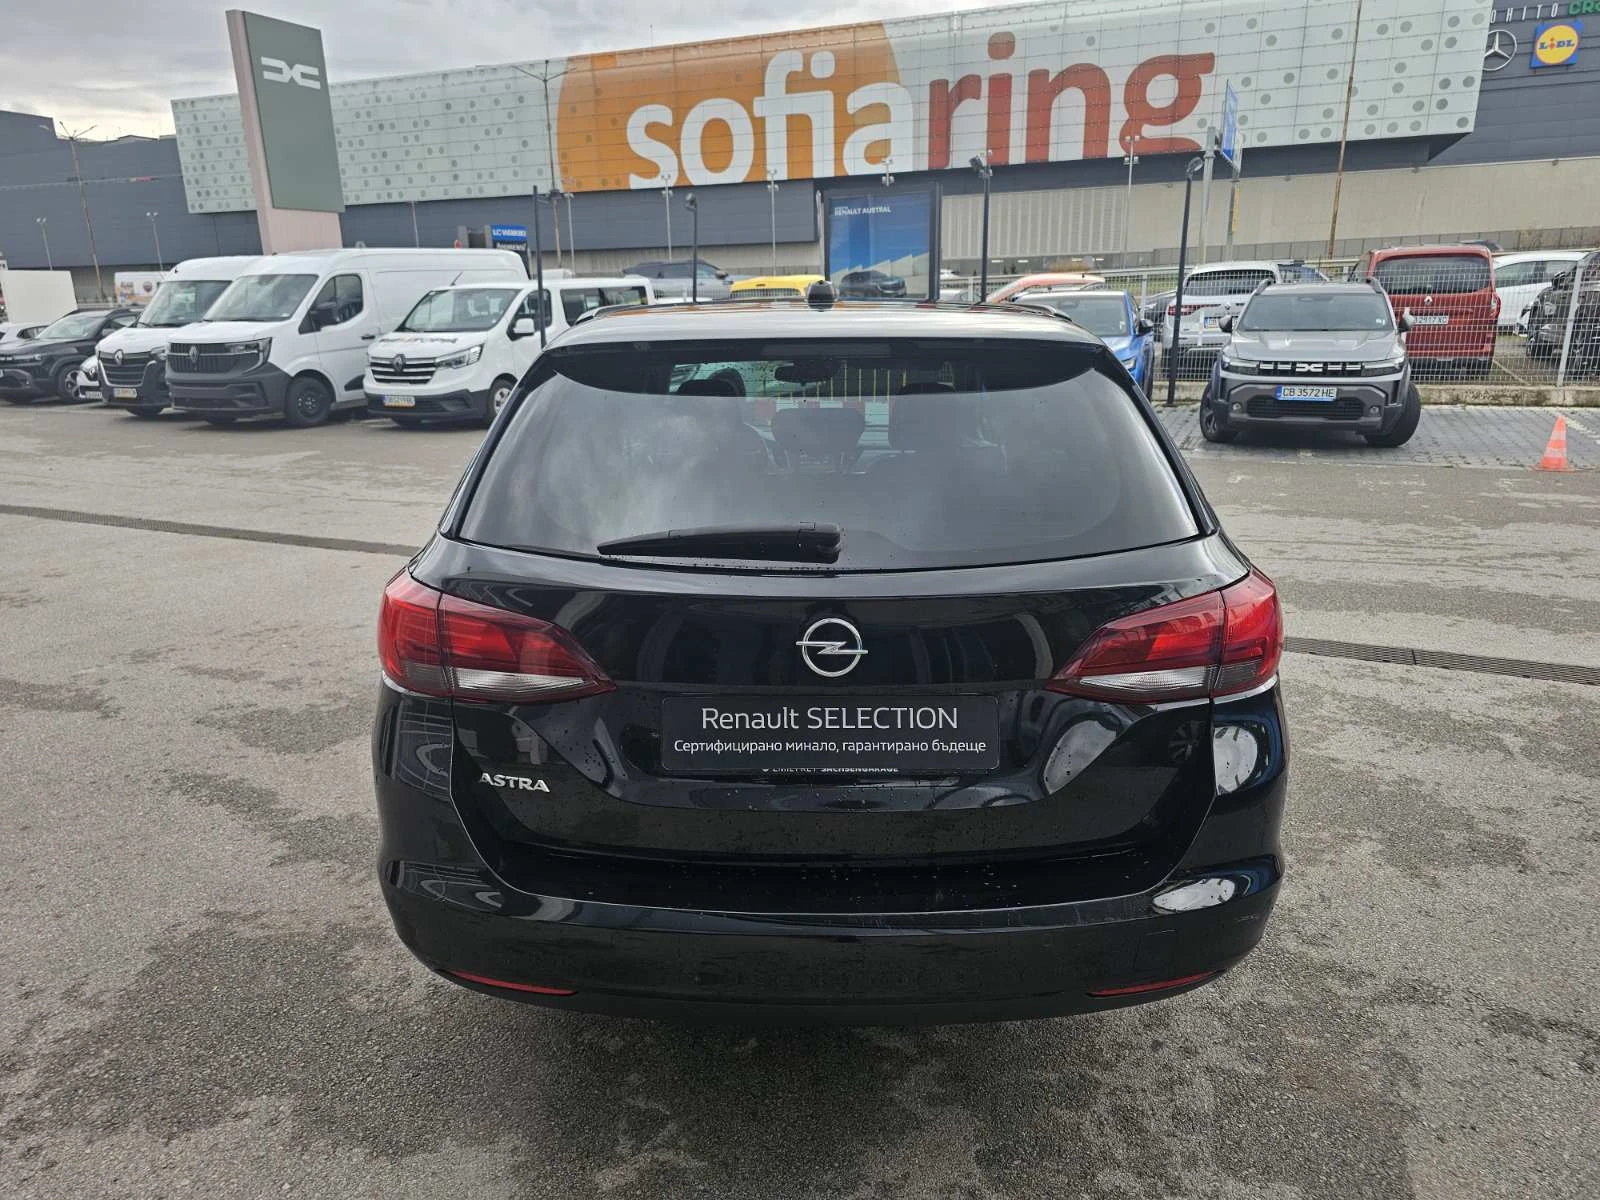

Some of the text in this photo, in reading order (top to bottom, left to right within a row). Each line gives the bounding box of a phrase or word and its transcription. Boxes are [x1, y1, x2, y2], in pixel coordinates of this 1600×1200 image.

[862, 206, 891, 214] AUSTRAL
[702, 706, 958, 729] Renault SELECTION
[674, 739, 987, 754] Сертифицирано минало, гарантирано бъдеще
[480, 772, 551, 793] ASTRA
